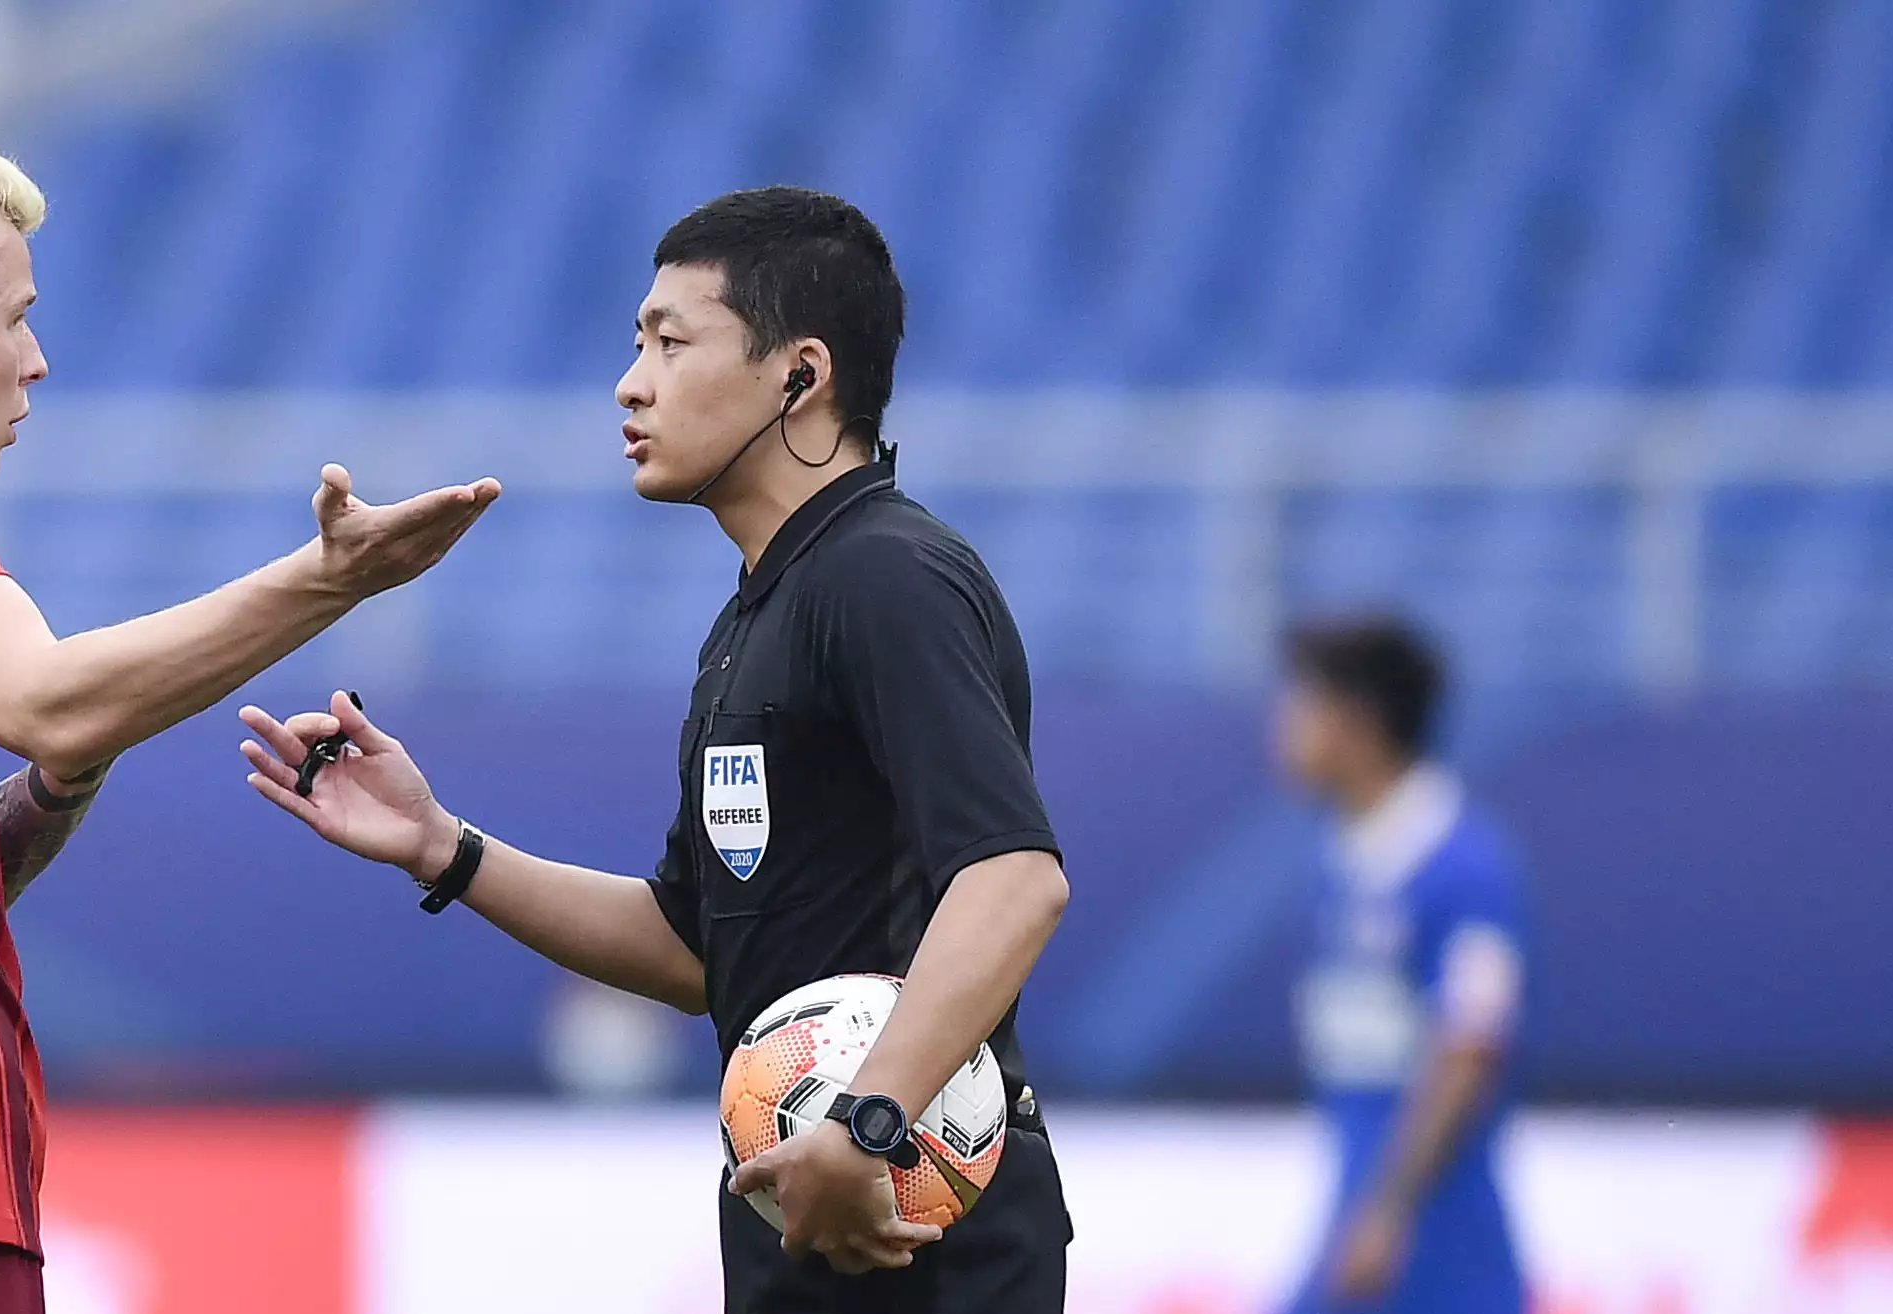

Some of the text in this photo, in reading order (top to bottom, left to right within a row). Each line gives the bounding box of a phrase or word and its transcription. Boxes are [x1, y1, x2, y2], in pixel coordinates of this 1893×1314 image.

[709, 754, 759, 786] FIFA
[708, 807, 764, 825] REFEREE
[729, 851, 753, 867] 2020
